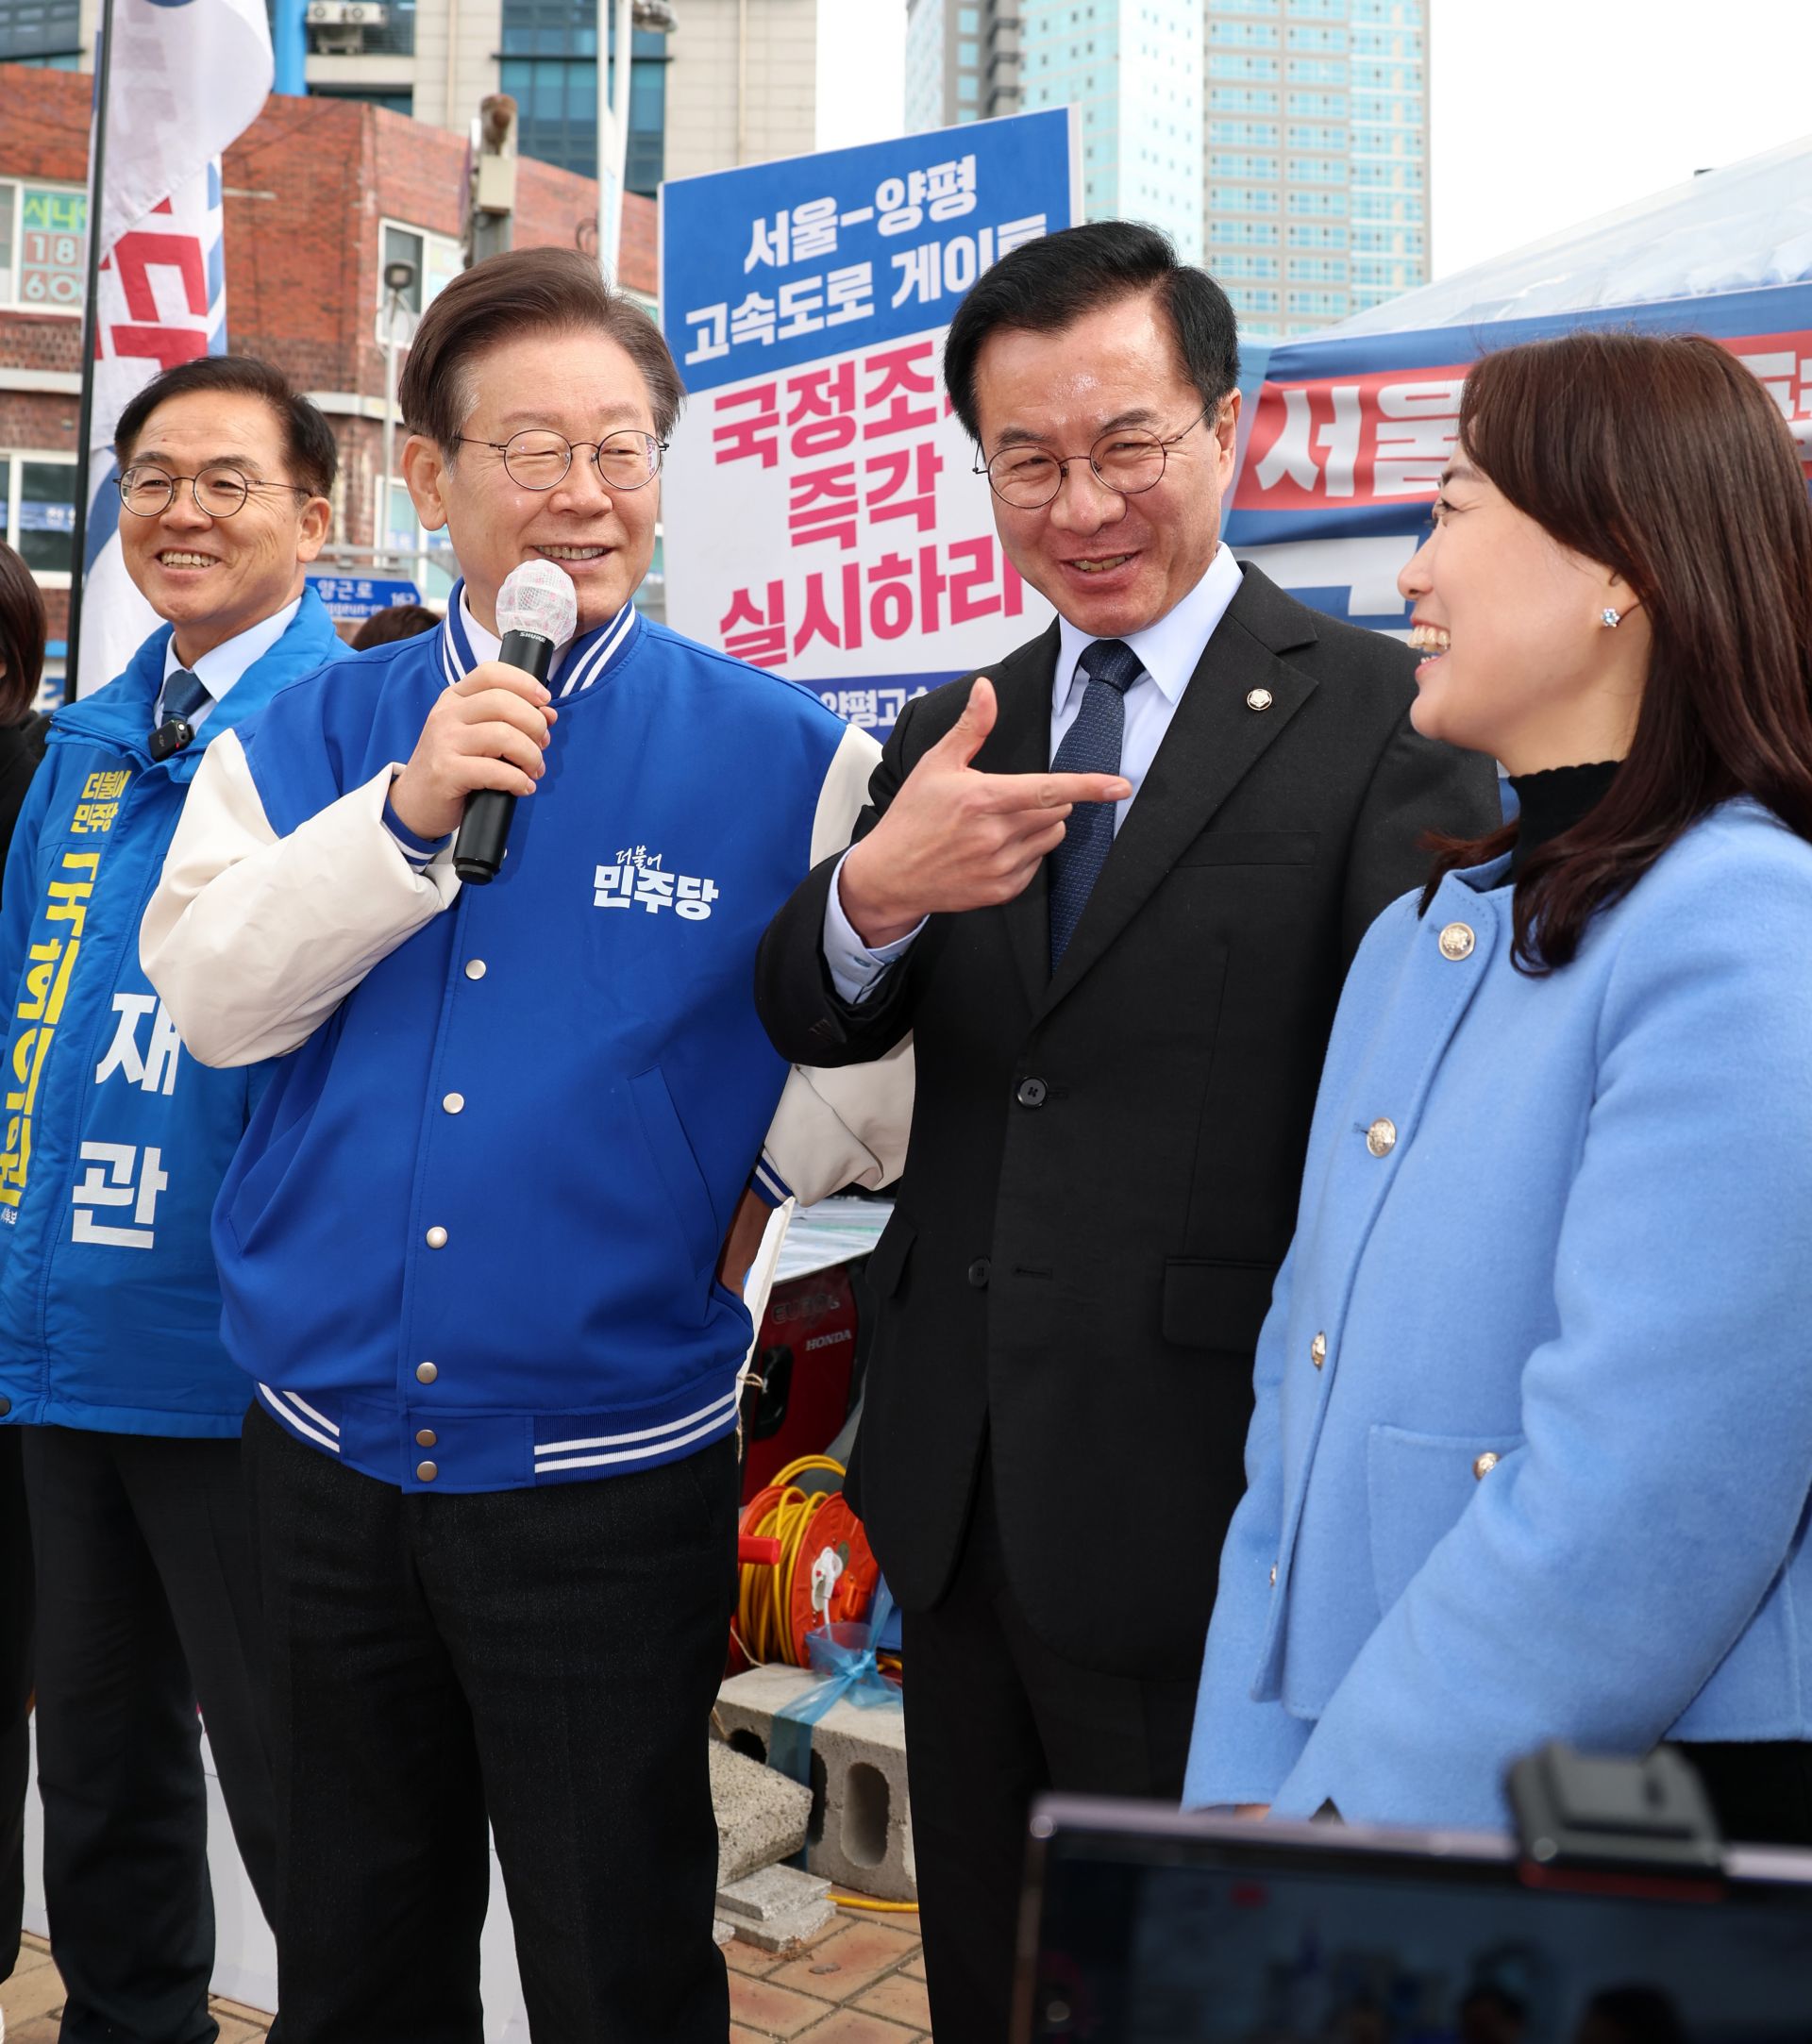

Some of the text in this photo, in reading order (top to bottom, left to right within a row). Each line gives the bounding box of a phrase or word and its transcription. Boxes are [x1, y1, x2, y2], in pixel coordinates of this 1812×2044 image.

[685, 261, 874, 365] 고속도로
[713, 341, 954, 469] 국정조
[1255, 379, 1468, 498] 서울
[788, 441, 943, 550] 즉각
[317, 579, 374, 601] 양근로
[519, 631, 546, 644] SHURE
[81, 769, 132, 800] 더불어
[70, 802, 119, 833] 민주당
[615, 845, 663, 871] 더불어
[593, 864, 719, 921] 민주당
[805, 1329, 852, 1351] HONDA
